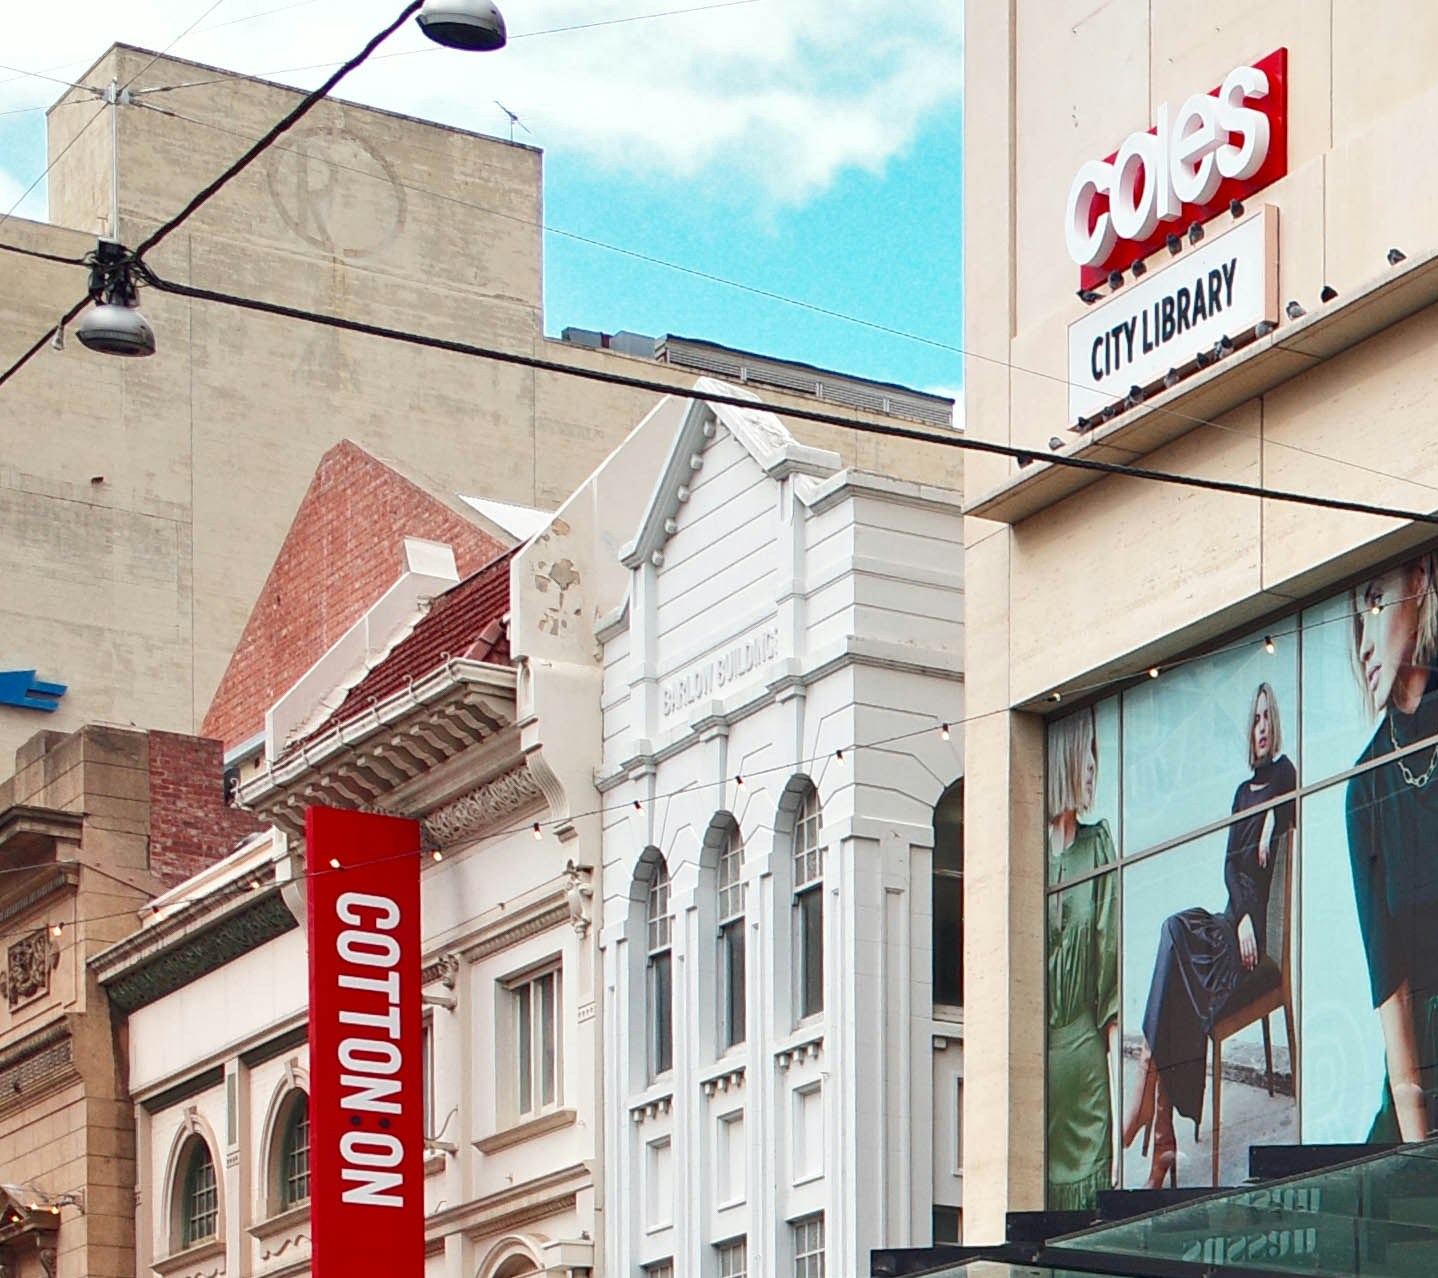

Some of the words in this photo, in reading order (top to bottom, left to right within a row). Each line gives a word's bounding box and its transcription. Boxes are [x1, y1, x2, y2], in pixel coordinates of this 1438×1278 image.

[1065, 66, 1270, 269] coles
[1090, 311, 1138, 382] CITY
[1141, 257, 1240, 353] LIBRARY
